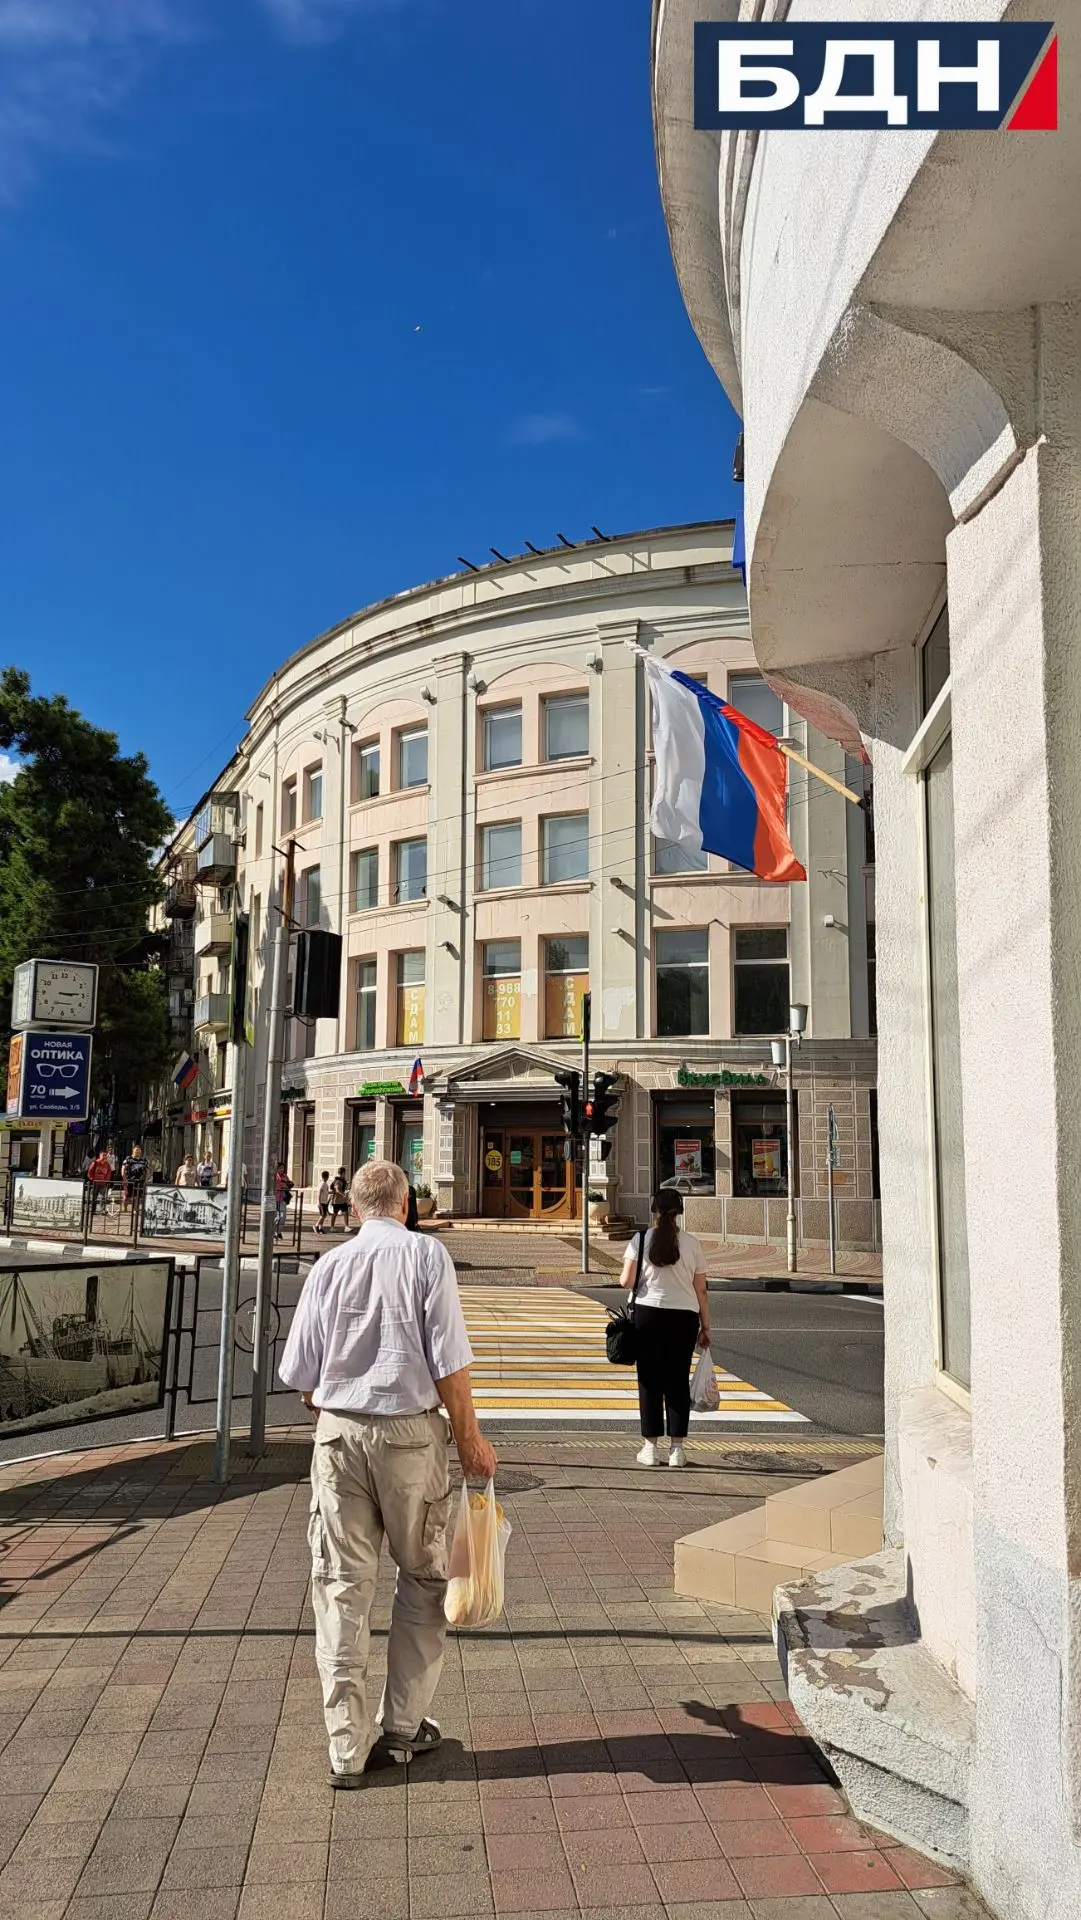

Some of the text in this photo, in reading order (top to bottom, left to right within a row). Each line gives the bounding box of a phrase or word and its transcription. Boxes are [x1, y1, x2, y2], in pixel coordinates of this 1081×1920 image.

[563, 976, 576, 1035] СДАМ
[409, 990, 418, 1042] СДАМ
[497, 1010, 511, 1021] 11
[496, 1023, 511, 1034] 33
[30, 1049, 84, 1060] ОПТИКА
[30, 1085, 46, 1095] 70
